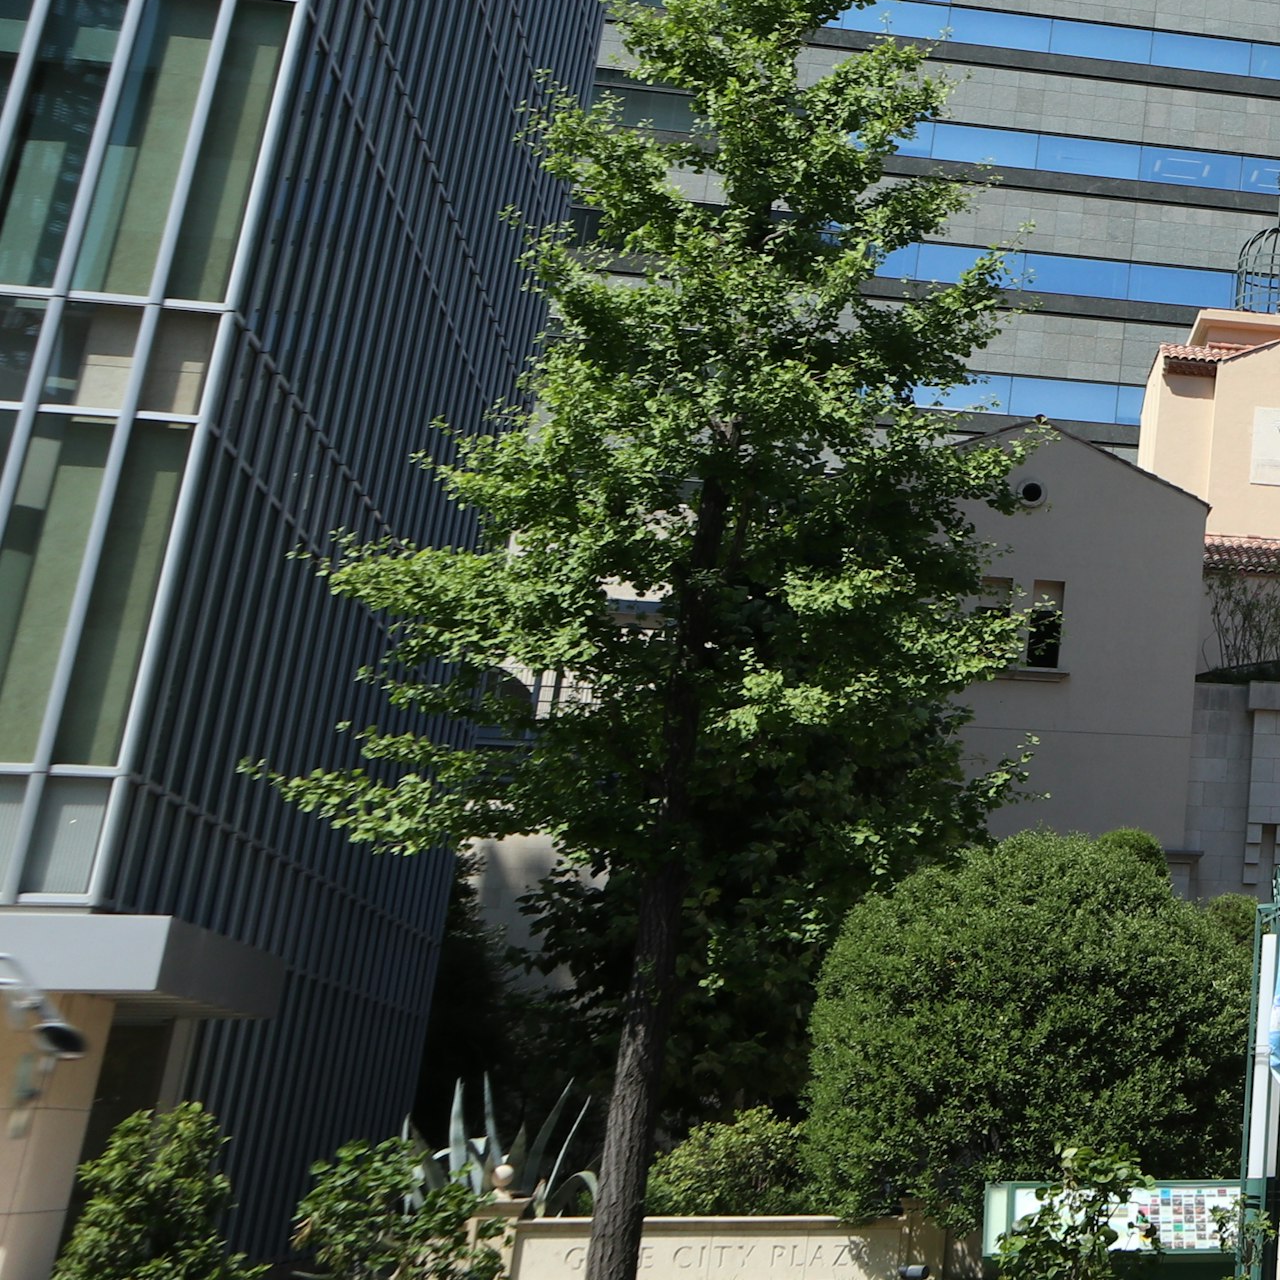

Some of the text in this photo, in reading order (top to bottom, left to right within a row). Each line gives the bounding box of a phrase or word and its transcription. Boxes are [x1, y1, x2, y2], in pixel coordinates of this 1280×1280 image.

[564, 1244, 869, 1270] GE CITY PLAZA
